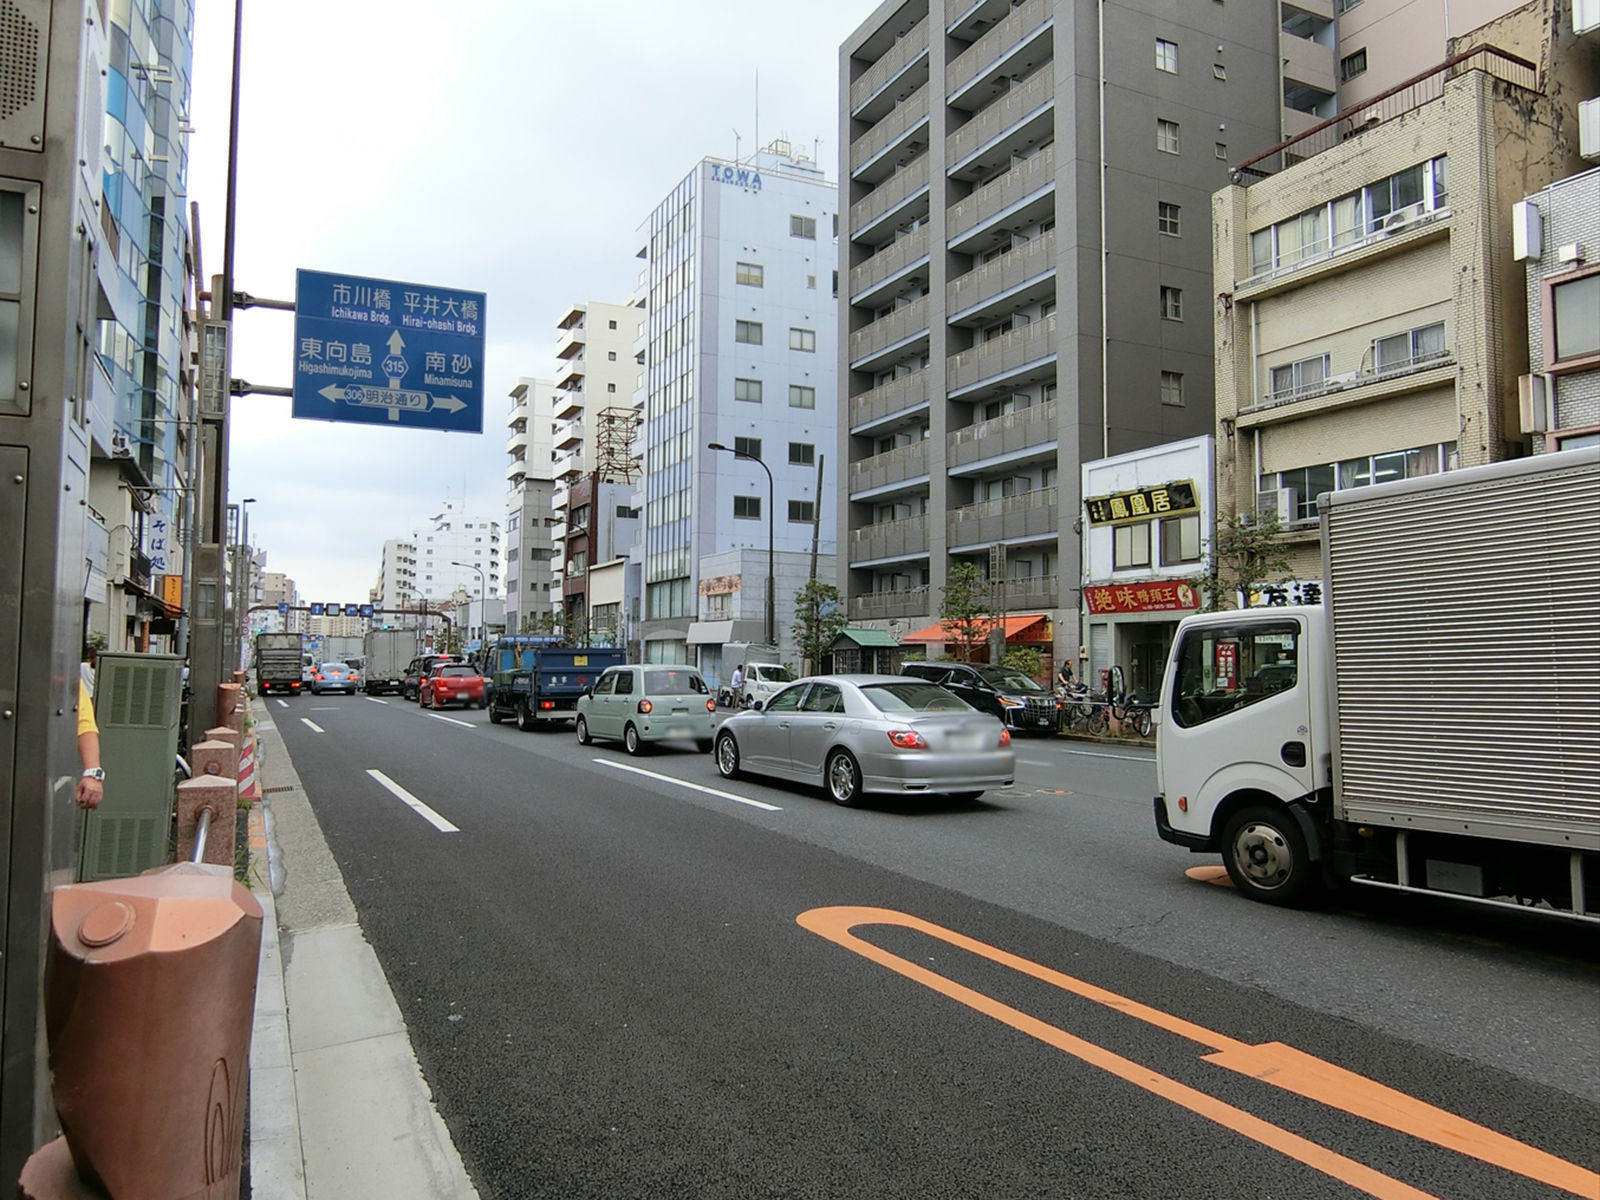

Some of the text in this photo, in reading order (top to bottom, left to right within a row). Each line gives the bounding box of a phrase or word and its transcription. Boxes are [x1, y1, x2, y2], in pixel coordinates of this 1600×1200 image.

[712, 165, 762, 184] TOWA
[333, 283, 478, 321] 市川橋 平井大橋
[331, 306, 391, 326] Ichikawa Brdg.
[402, 315, 478, 336] Hirai-ohashi Brdg.
[300, 337, 372, 365] 東向島
[299, 360, 373, 379] Higashimukojima
[385, 360, 404, 373] 315
[425, 351, 472, 375] 南砂
[424, 373, 473, 389] Minamisuna
[346, 388, 363, 400] 306
[365, 389, 422, 407] 明治通り
[1109, 489, 1171, 519] 鳳凰居
[150, 520, 166, 571] そば処
